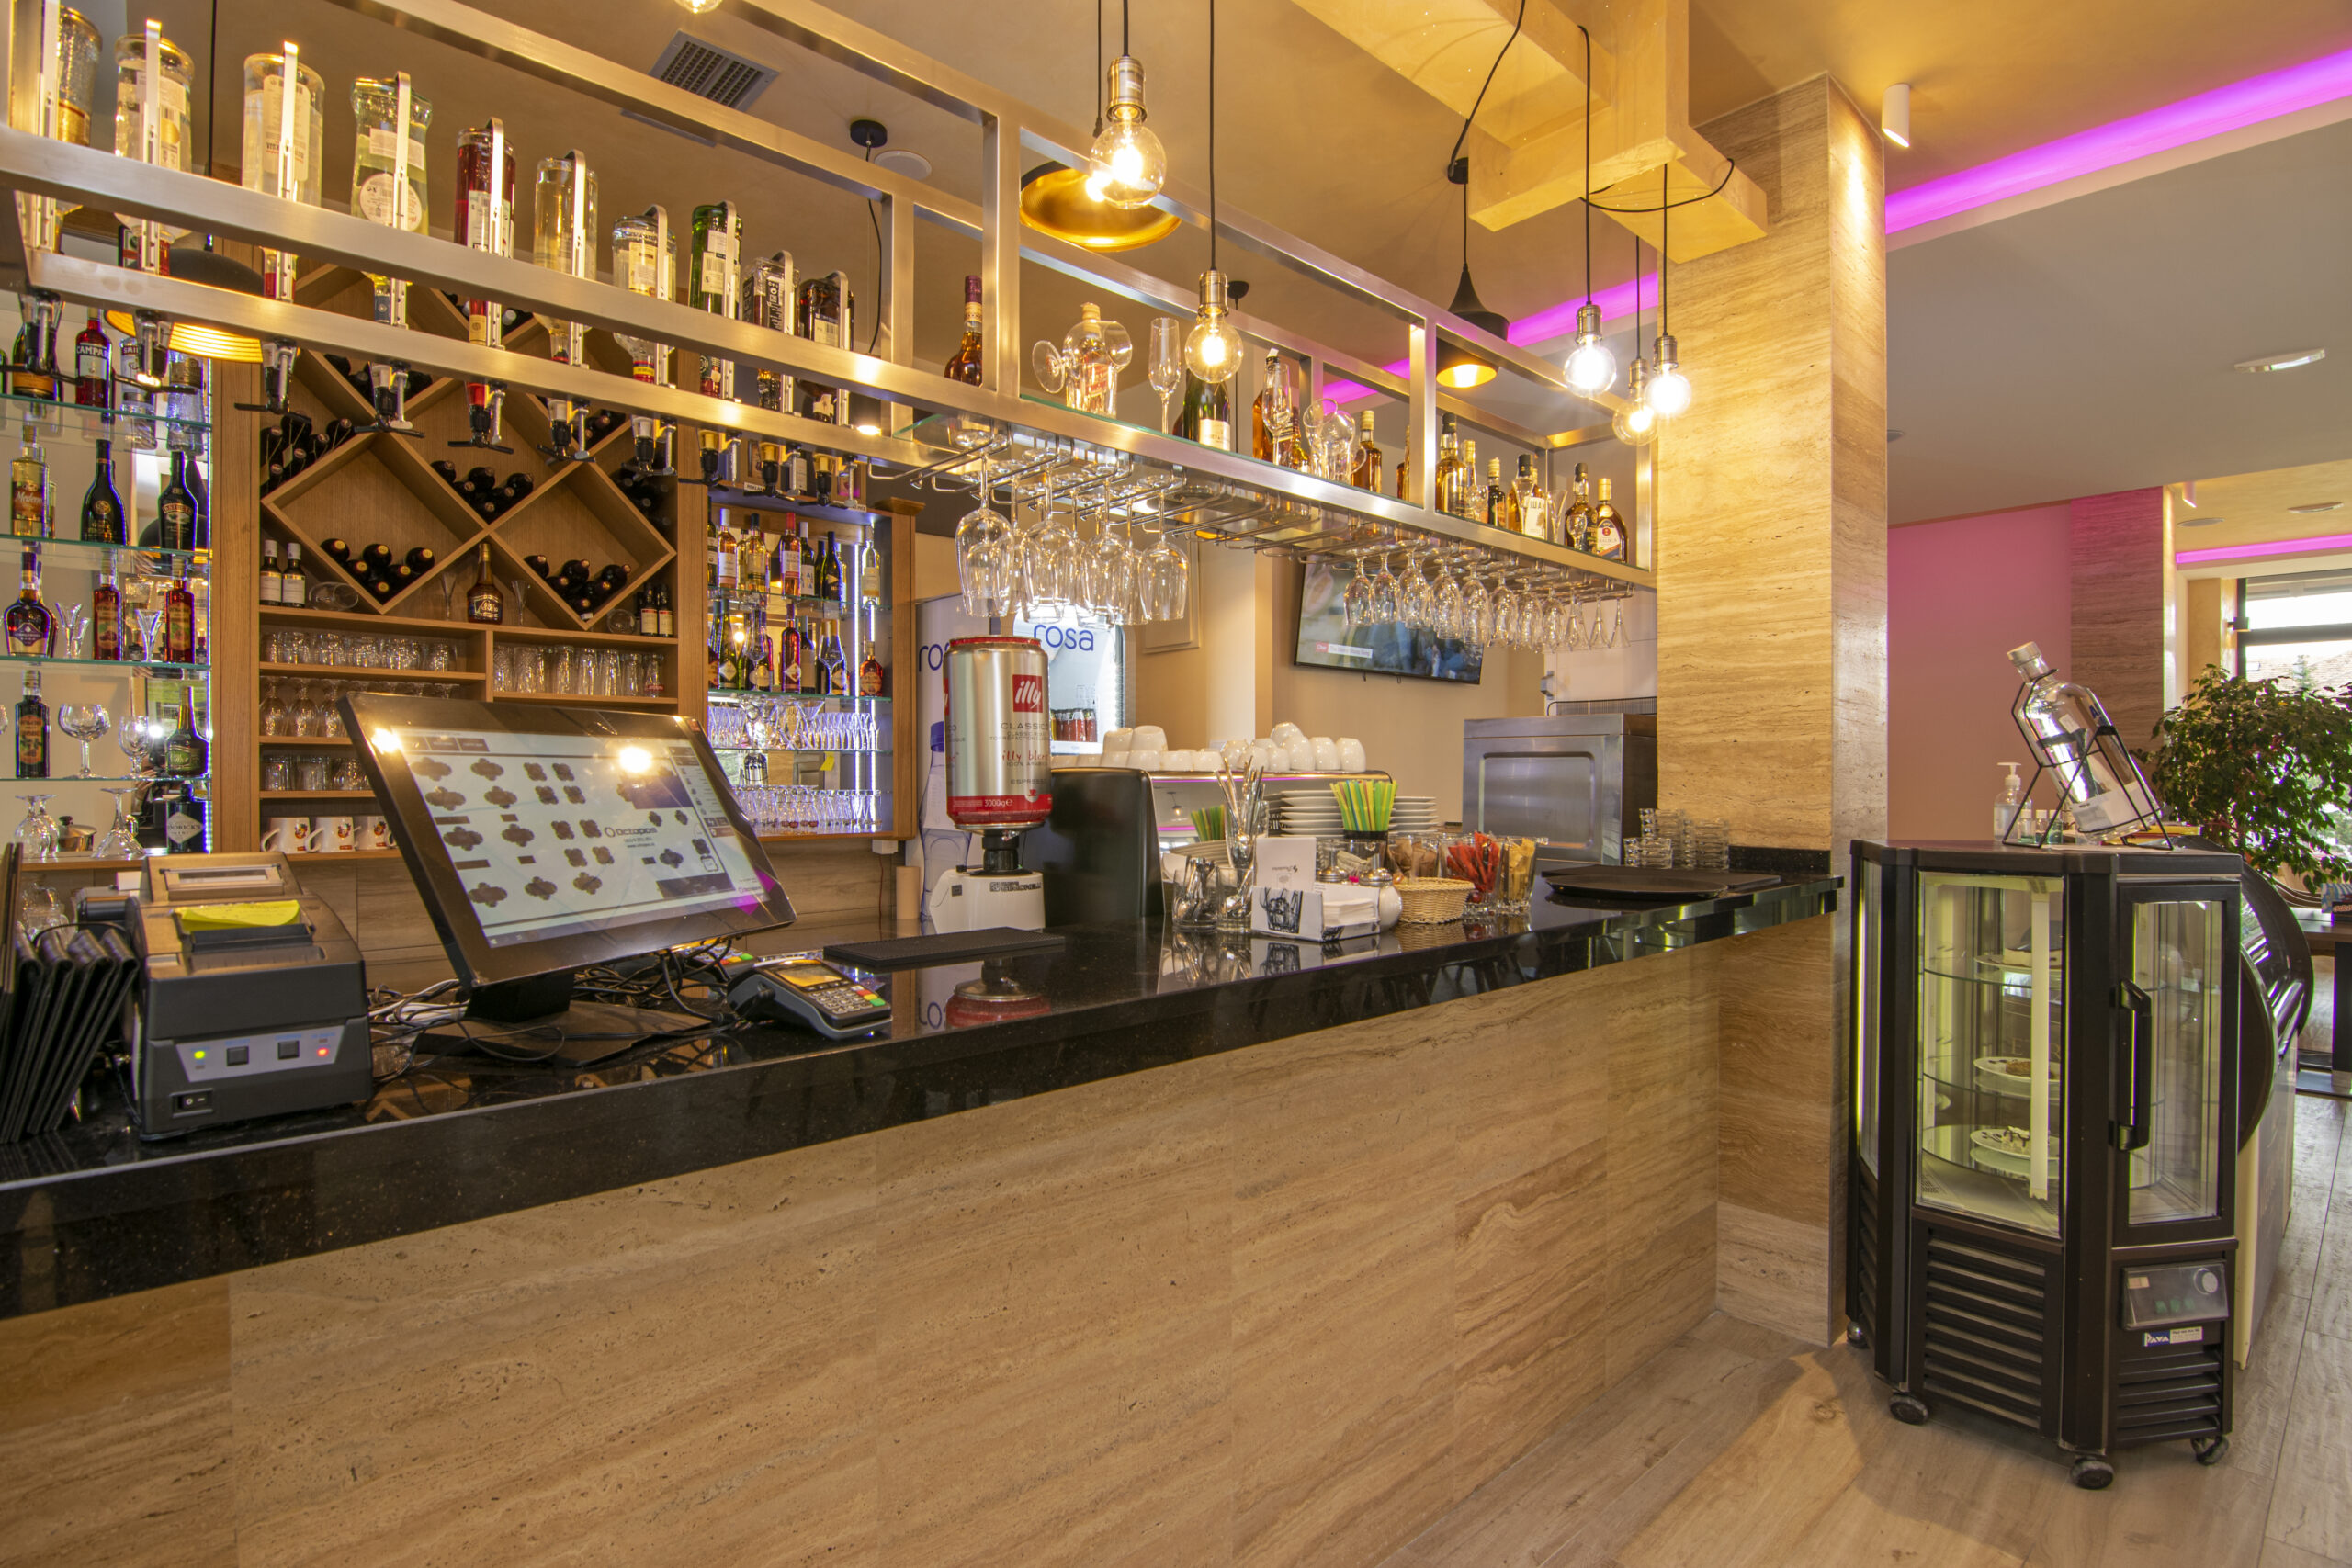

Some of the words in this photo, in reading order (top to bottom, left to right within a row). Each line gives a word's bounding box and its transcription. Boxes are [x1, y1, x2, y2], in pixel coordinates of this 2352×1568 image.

[1034, 625, 1093, 651] rosa
[919, 642, 949, 671] ro
[1014, 681, 1041, 709] illy
